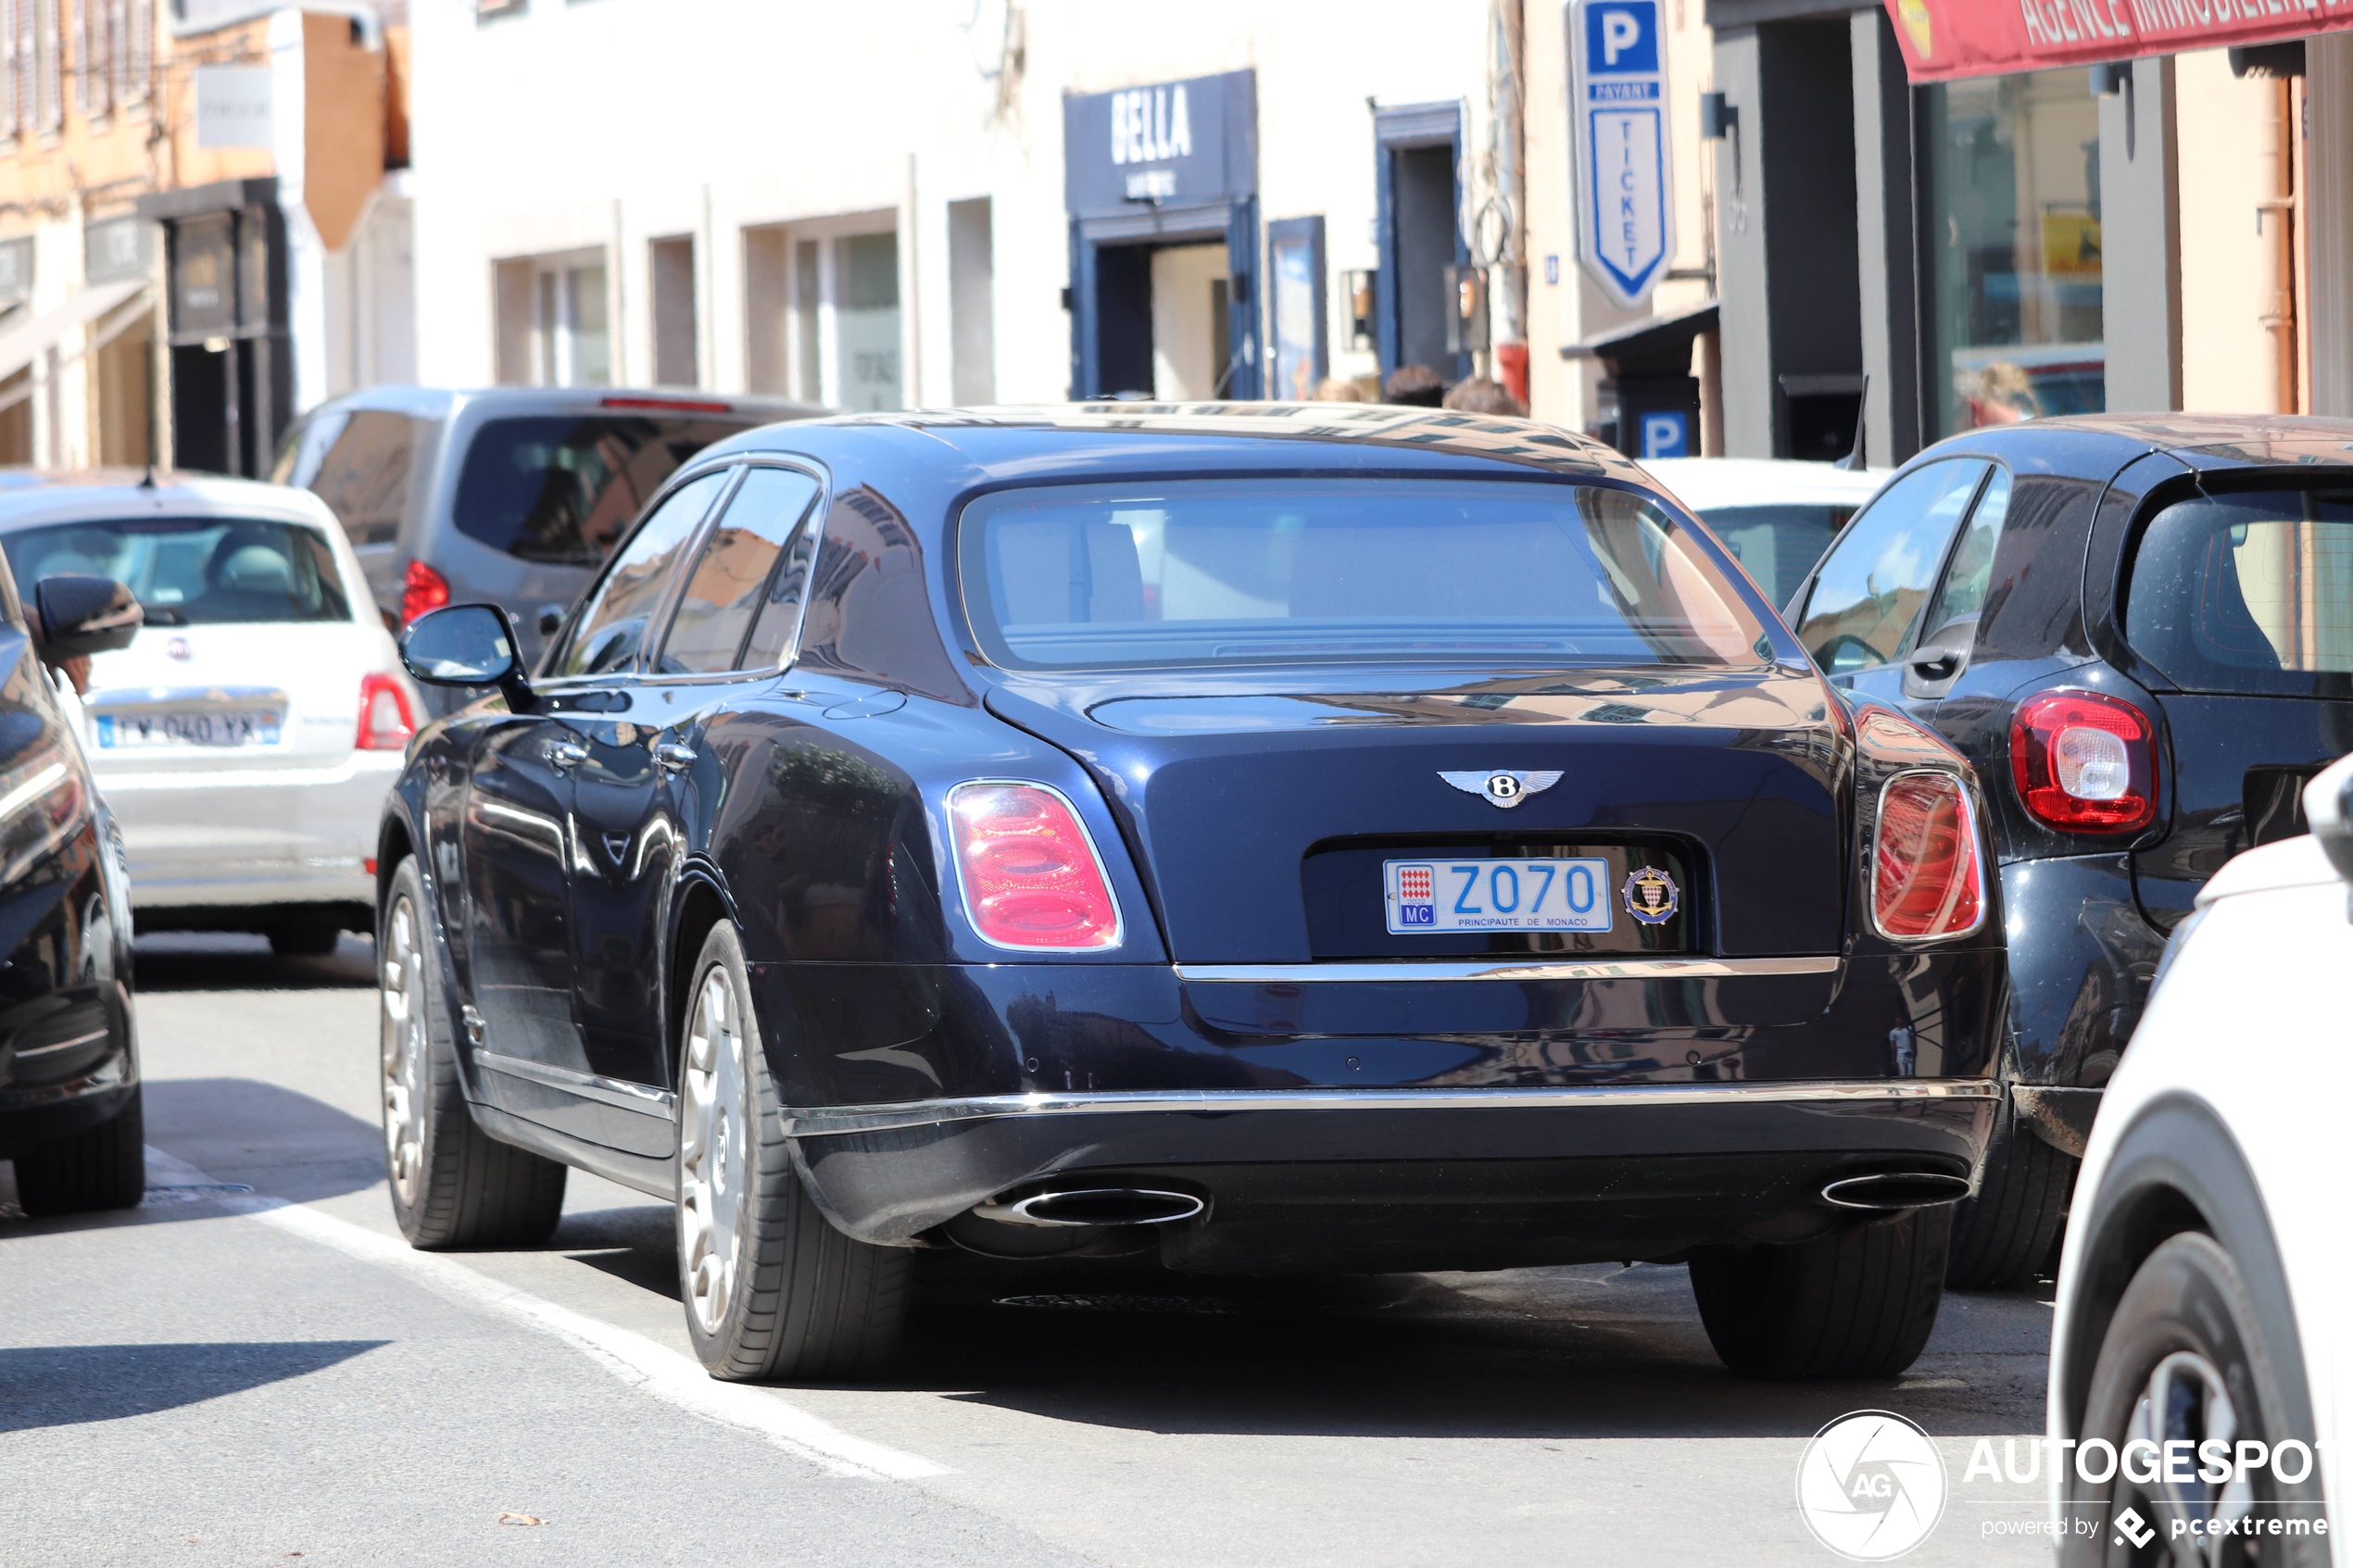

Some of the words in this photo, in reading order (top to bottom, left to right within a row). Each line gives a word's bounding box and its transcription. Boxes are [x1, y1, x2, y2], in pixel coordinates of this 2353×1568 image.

[1602, 10, 1639, 66] P
[1595, 84, 1650, 100] PAYANT
[1113, 83, 1191, 165] BELLA
[1621, 121, 1637, 266] TICKET
[1646, 419, 1679, 459] P
[1491, 775, 1516, 797] B
[1451, 865, 1594, 914] Z070
[1406, 907, 1428, 922] MC
[1458, 918, 1519, 926] PRINCIPAUTE
[1527, 918, 1540, 926] DE
[1547, 918, 1588, 926] MONACO
